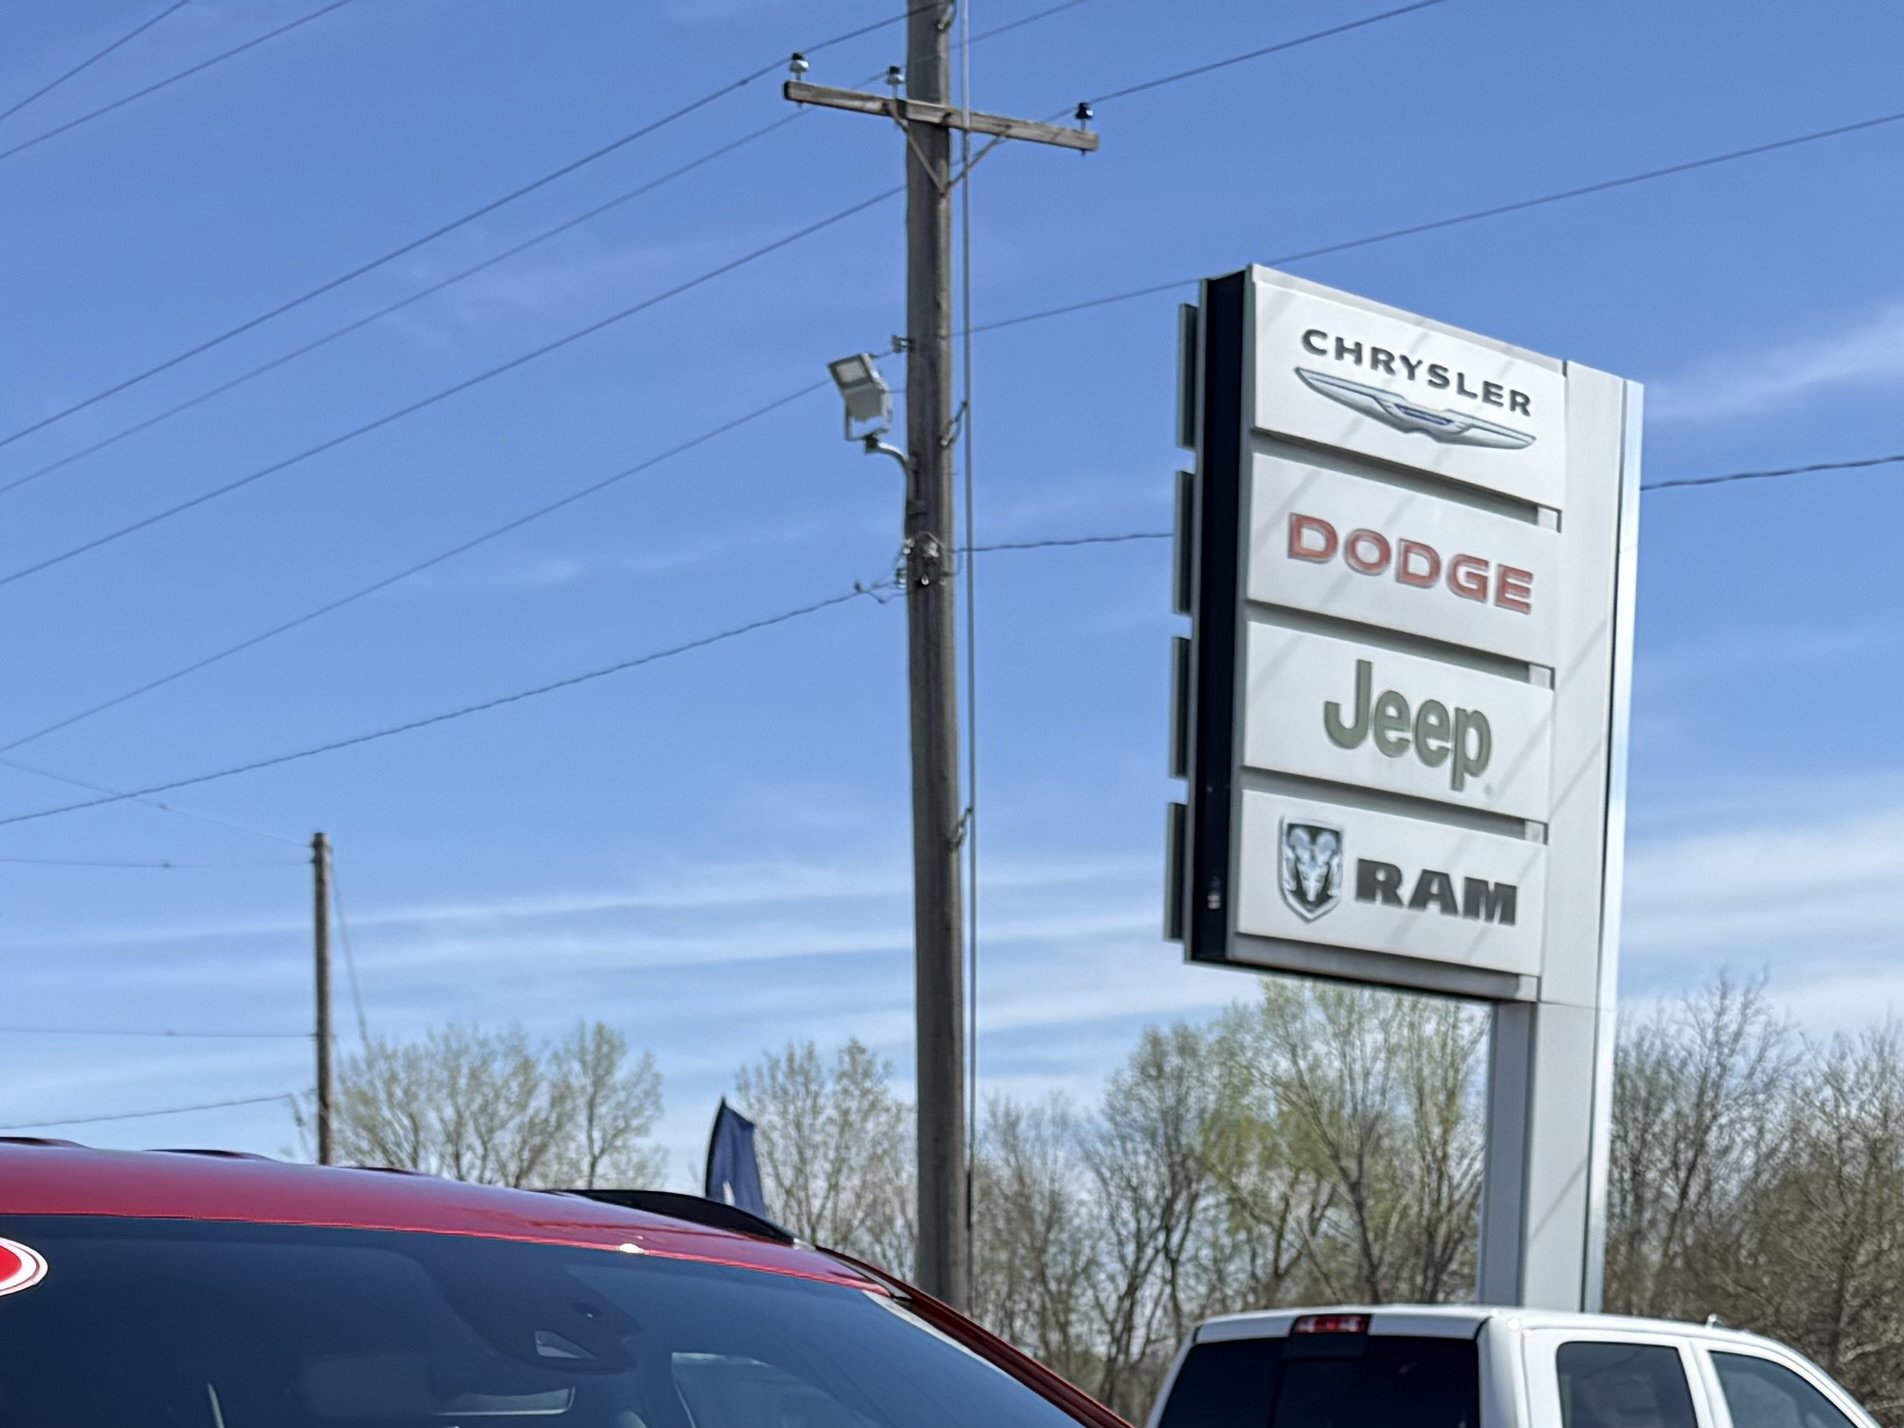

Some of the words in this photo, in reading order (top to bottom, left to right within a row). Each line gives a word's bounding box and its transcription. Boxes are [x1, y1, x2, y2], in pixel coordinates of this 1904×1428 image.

[1301, 328, 1534, 418] CHRYSLER
[1287, 512, 1535, 614] DODGE
[1323, 658, 1493, 790] Jeep
[1355, 858, 1518, 926] RAM
